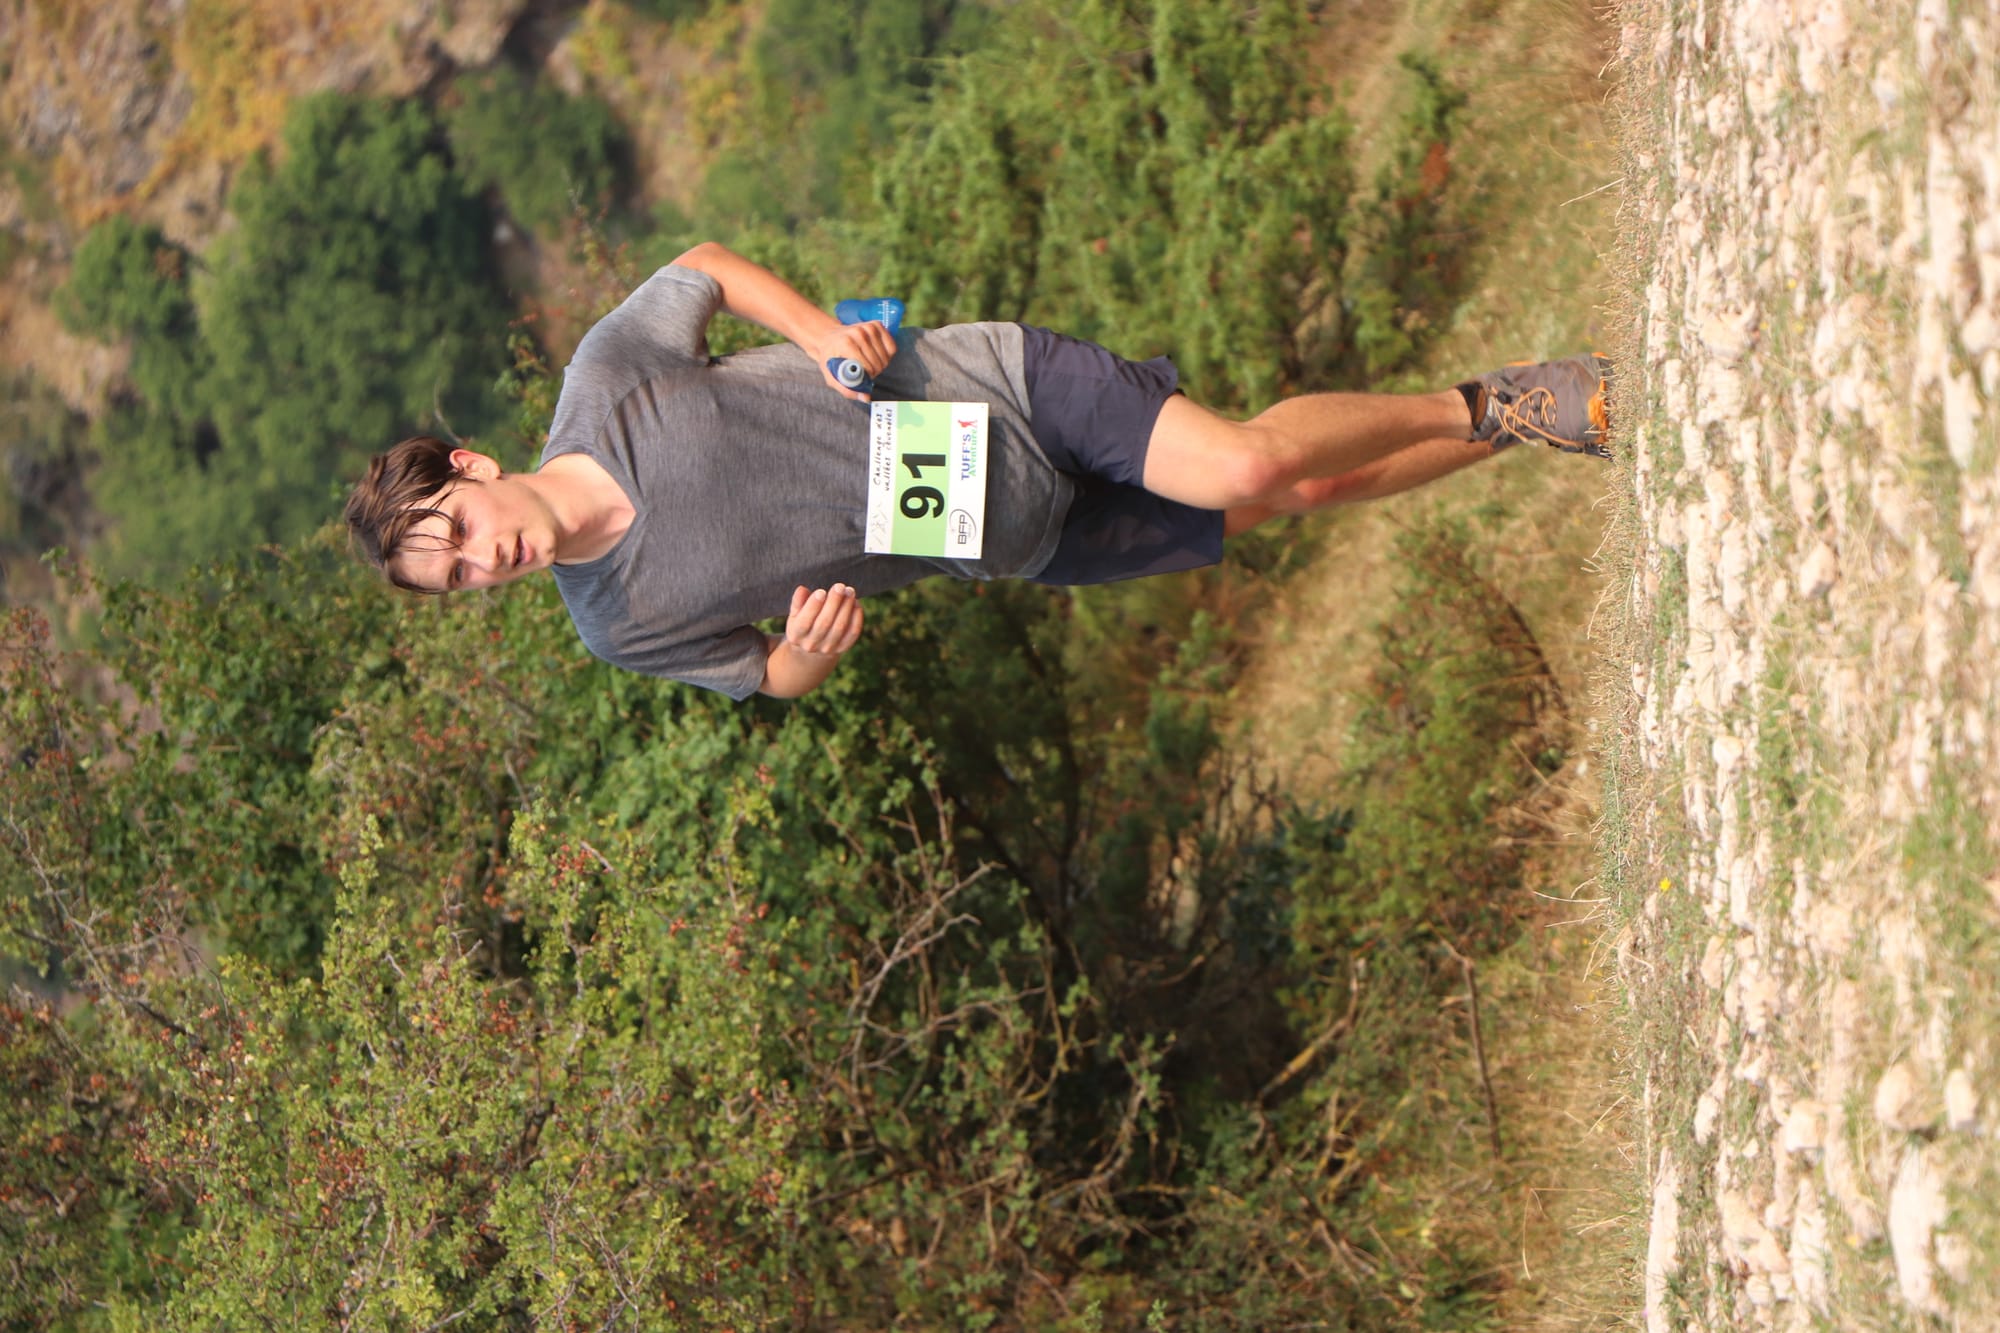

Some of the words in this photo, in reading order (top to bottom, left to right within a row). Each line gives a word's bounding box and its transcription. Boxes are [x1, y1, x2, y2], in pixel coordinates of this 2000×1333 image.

[875, 413, 883, 430] des
[873, 436, 885, 485] Challenge
[961, 433, 971, 480] TUFF'S
[900, 453, 946, 519] 91
[958, 514, 968, 545] BFP
